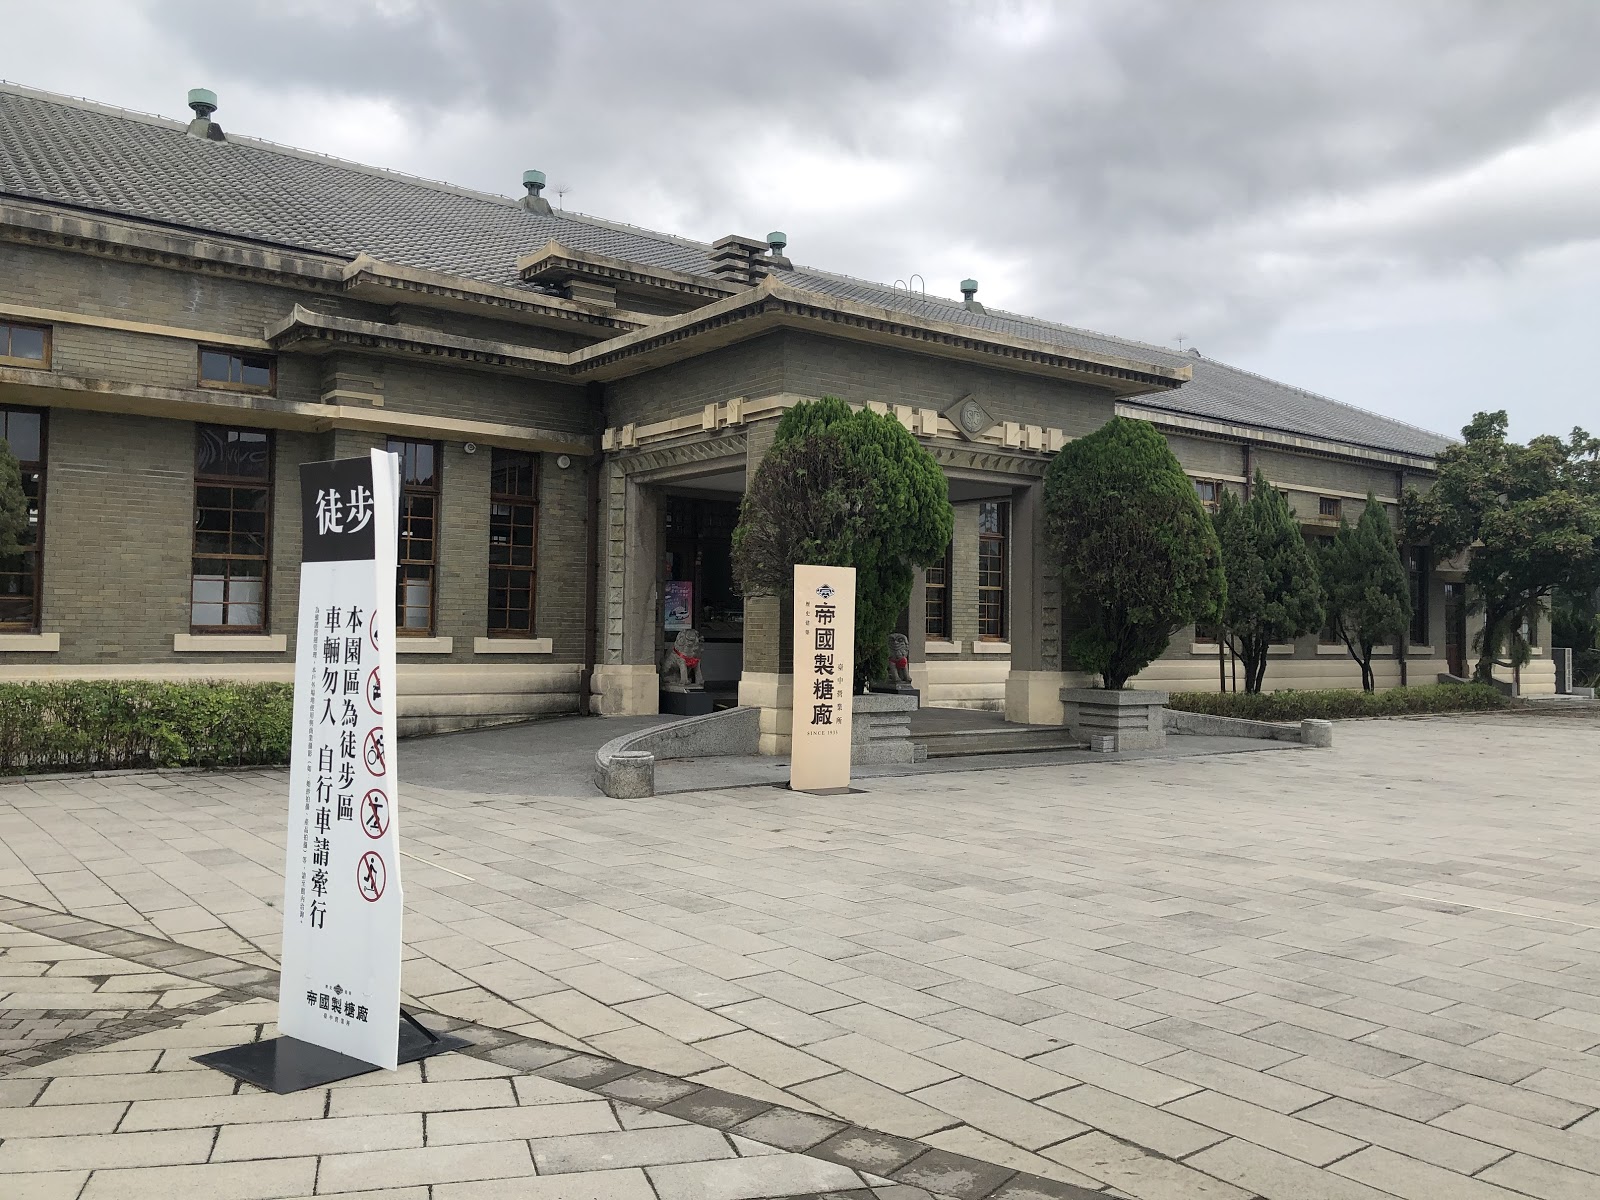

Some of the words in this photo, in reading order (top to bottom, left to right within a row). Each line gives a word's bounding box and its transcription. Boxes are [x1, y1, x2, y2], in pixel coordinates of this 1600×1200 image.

[315, 485, 374, 536] 徒步
[319, 605, 342, 726] 車輛勿入
[337, 605, 364, 822] 本園區為徒步區
[810, 602, 836, 725] 帝國製糖廠
[310, 744, 335, 930] 自行車請牽行
[306, 989, 369, 1023] 帝國製糖廠
